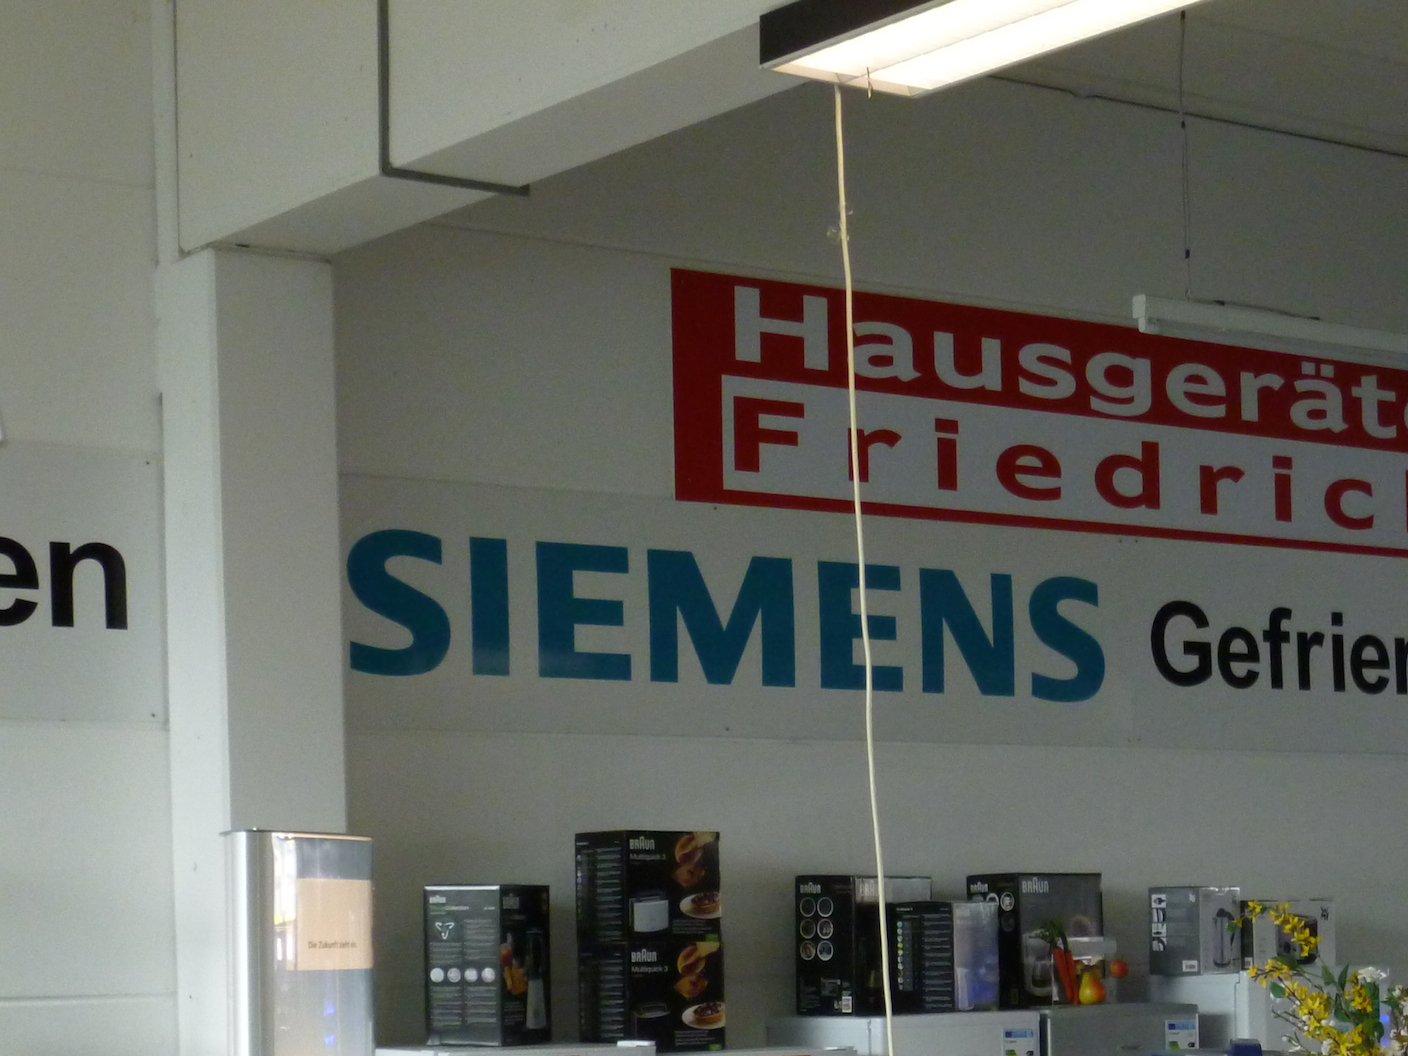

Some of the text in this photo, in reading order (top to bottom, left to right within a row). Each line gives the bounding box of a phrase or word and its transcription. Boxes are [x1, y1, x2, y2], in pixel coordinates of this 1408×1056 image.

[346, 528, 1106, 703] SIEMENS
[630, 836, 655, 850] BRAUN
[800, 882, 821, 894] BRAUN
[970, 883, 988, 893] BRAUN
[1022, 877, 1050, 893] BRAUN
[308, 941, 317, 949] Die
[318, 941, 338, 949] Zukunft
[631, 949, 657, 962] BRAUN
